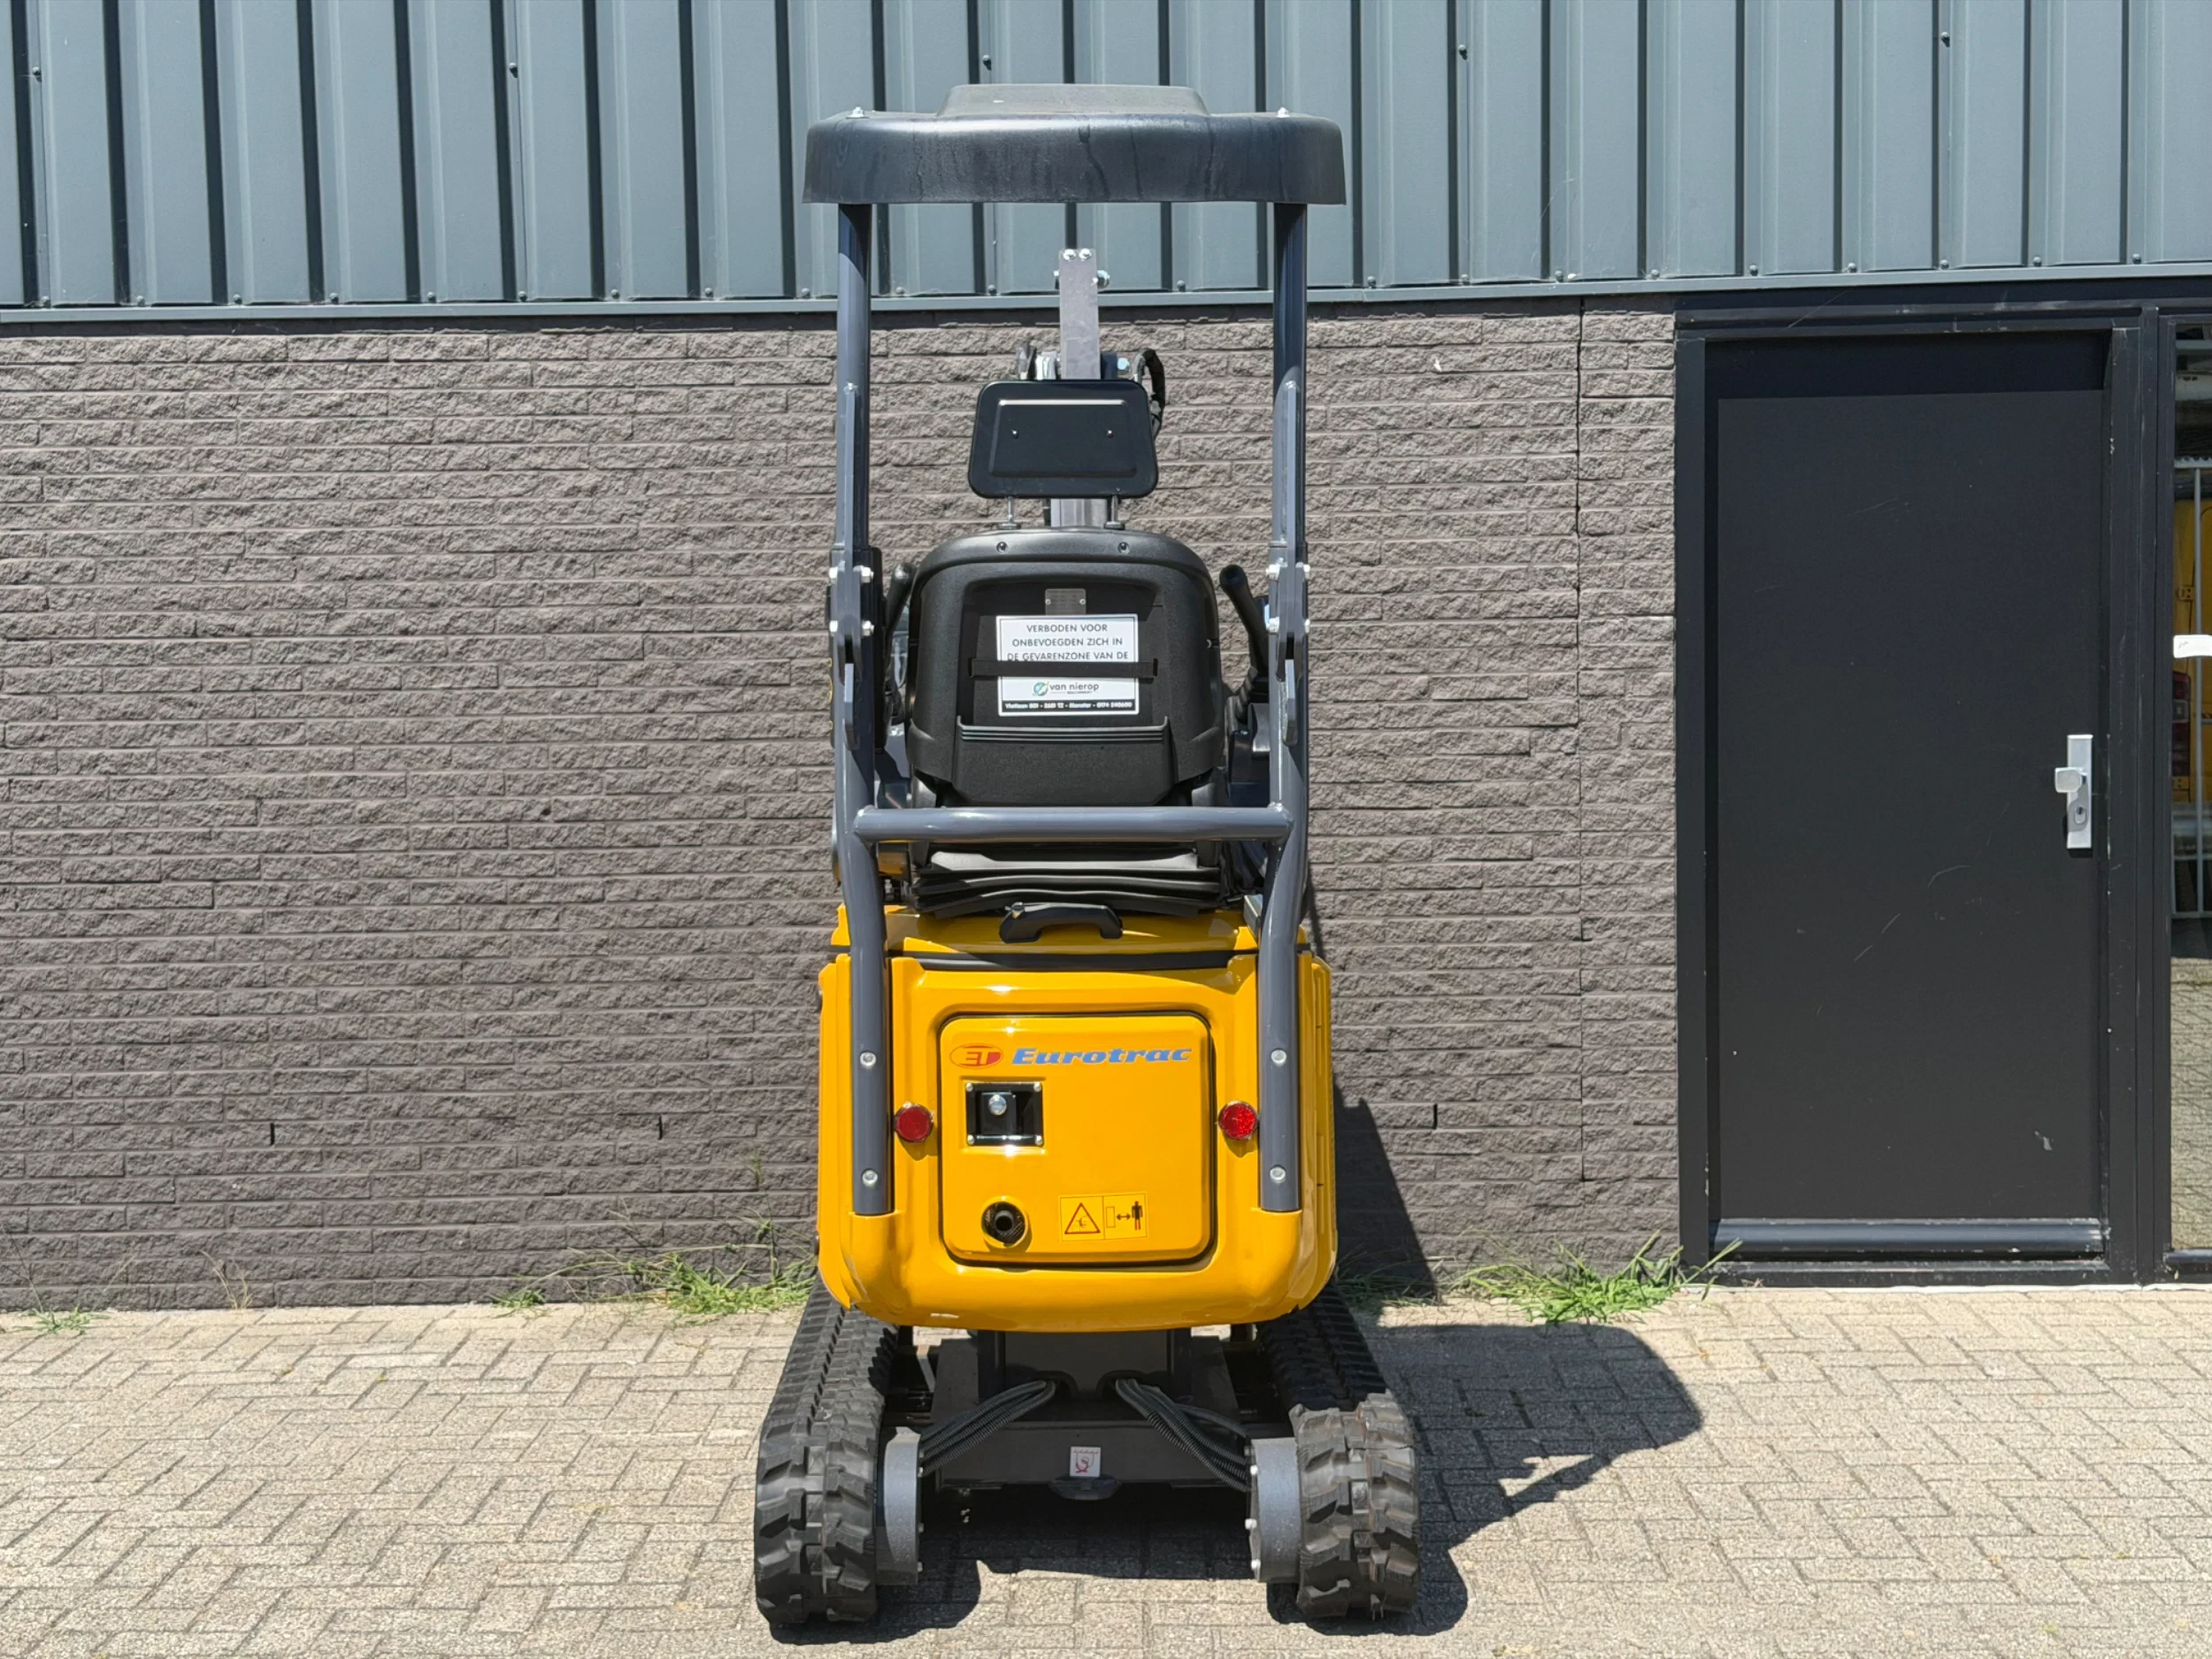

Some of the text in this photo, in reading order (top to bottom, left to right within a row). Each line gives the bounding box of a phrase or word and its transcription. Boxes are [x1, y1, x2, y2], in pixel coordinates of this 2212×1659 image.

[1026, 624, 1077, 633] VERBODEN
[1012, 638, 1084, 647] ONBEVOEGDEN
[1112, 637, 1123, 646] IN
[1007, 652, 1019, 661] DE
[1022, 651, 1091, 661] GEVARENZONE
[1094, 651, 1113, 660] VAN
[1069, 681, 1100, 692] nierop
[1011, 1047, 1193, 1066] Eurotrac
